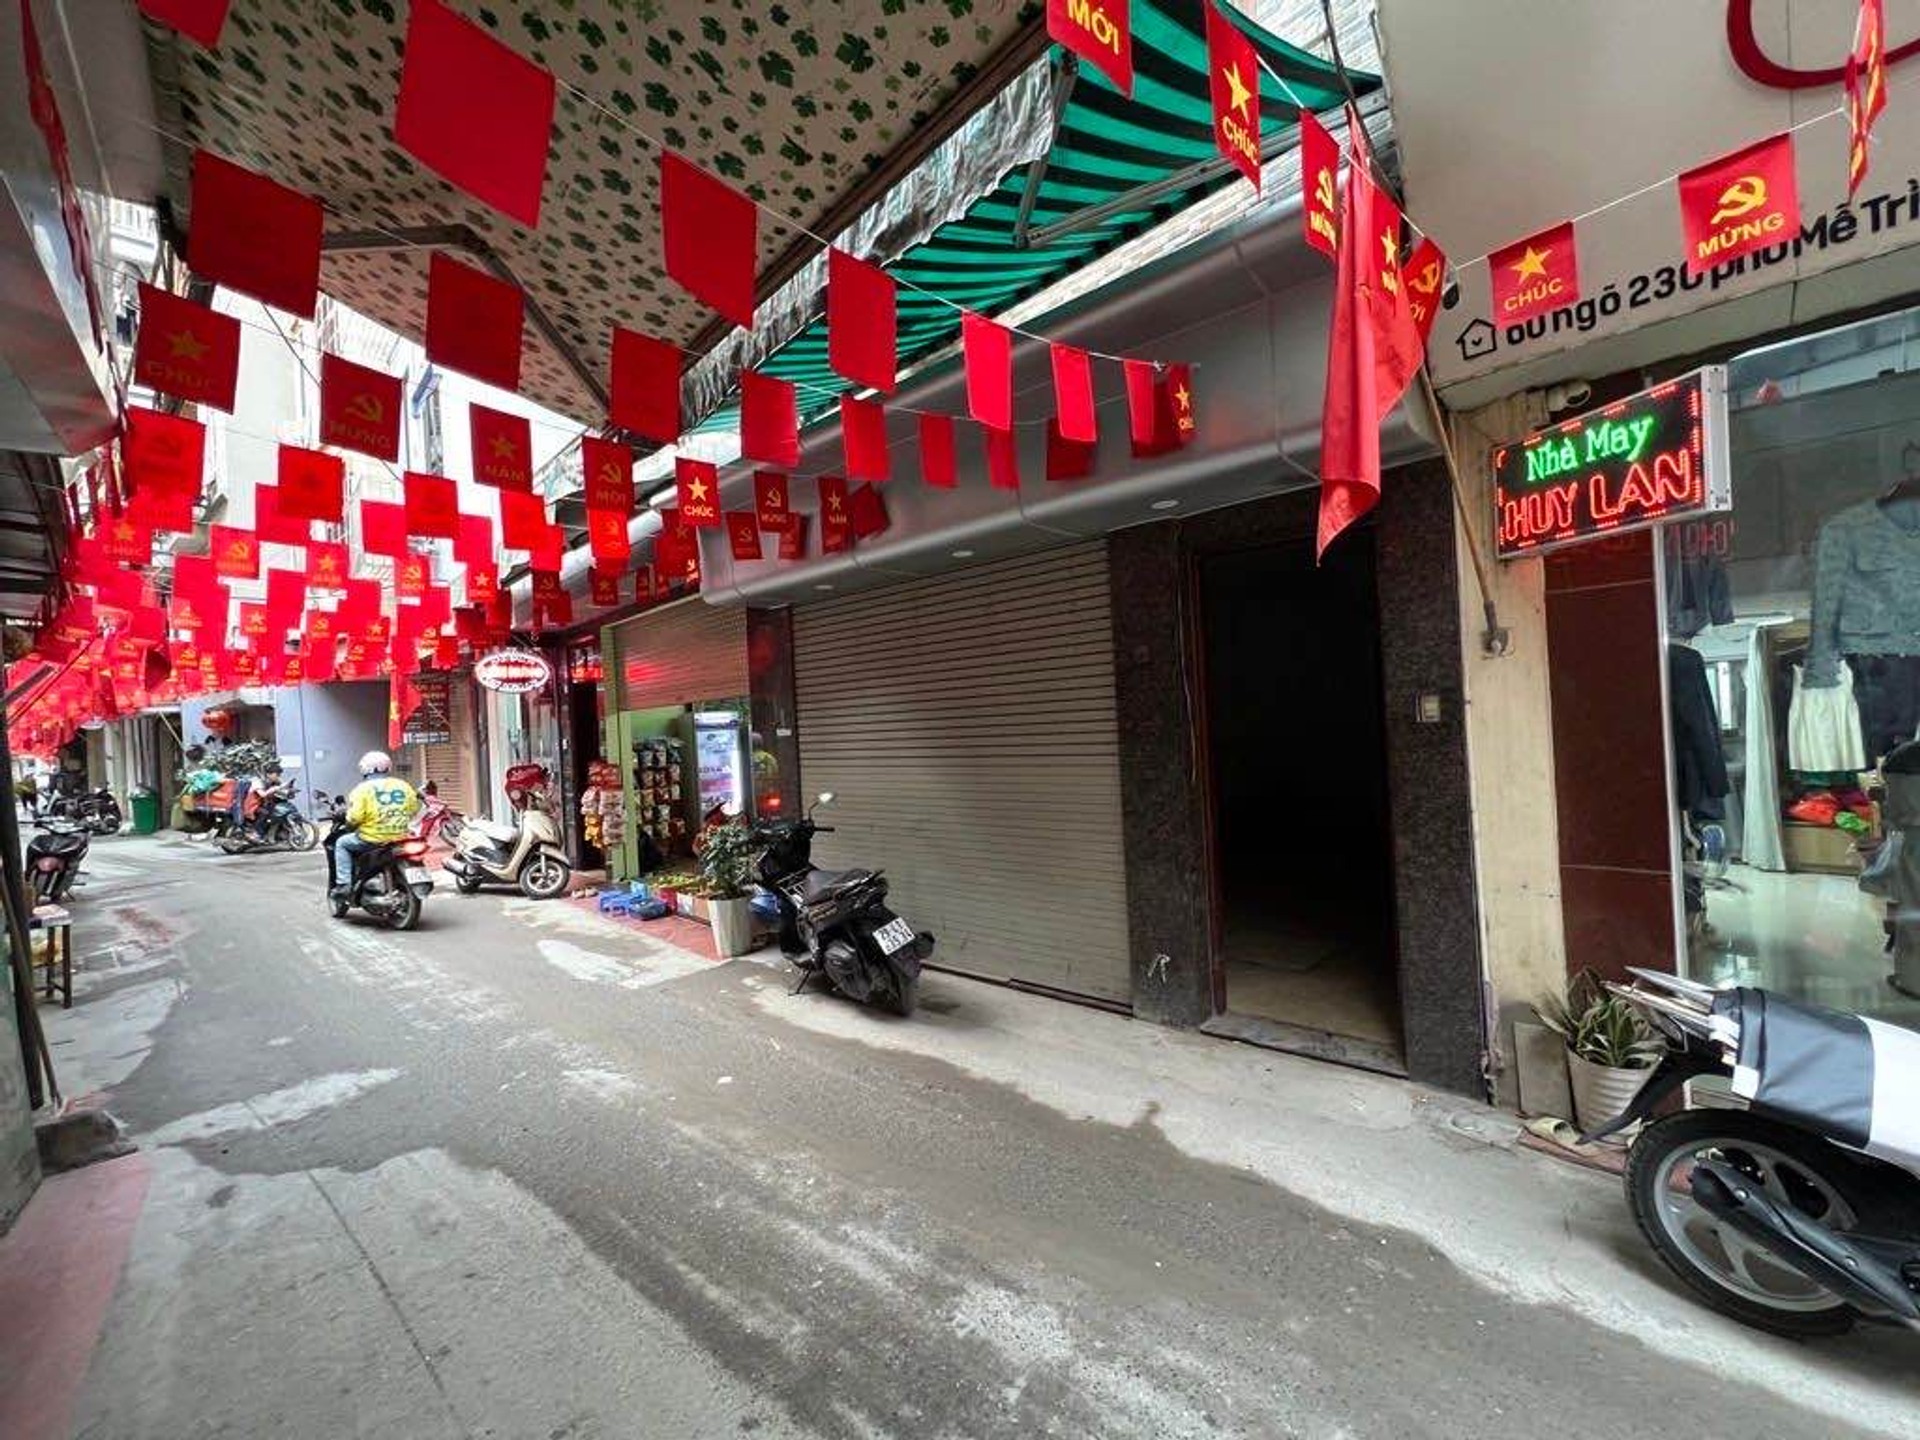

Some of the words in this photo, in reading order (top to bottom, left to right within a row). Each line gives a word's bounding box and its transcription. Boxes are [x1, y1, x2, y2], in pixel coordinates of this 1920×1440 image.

[1222, 116, 1260, 166] CHÚC
[1698, 211, 1785, 259] MỪNG
[1504, 277, 1564, 312] CHÚC
[1552, 285, 1621, 333] ngõ
[1525, 436, 1578, 482] Nhà
[1585, 415, 1655, 462] May
[1504, 482, 1578, 542] HUY
[1589, 448, 1690, 519] LAN
